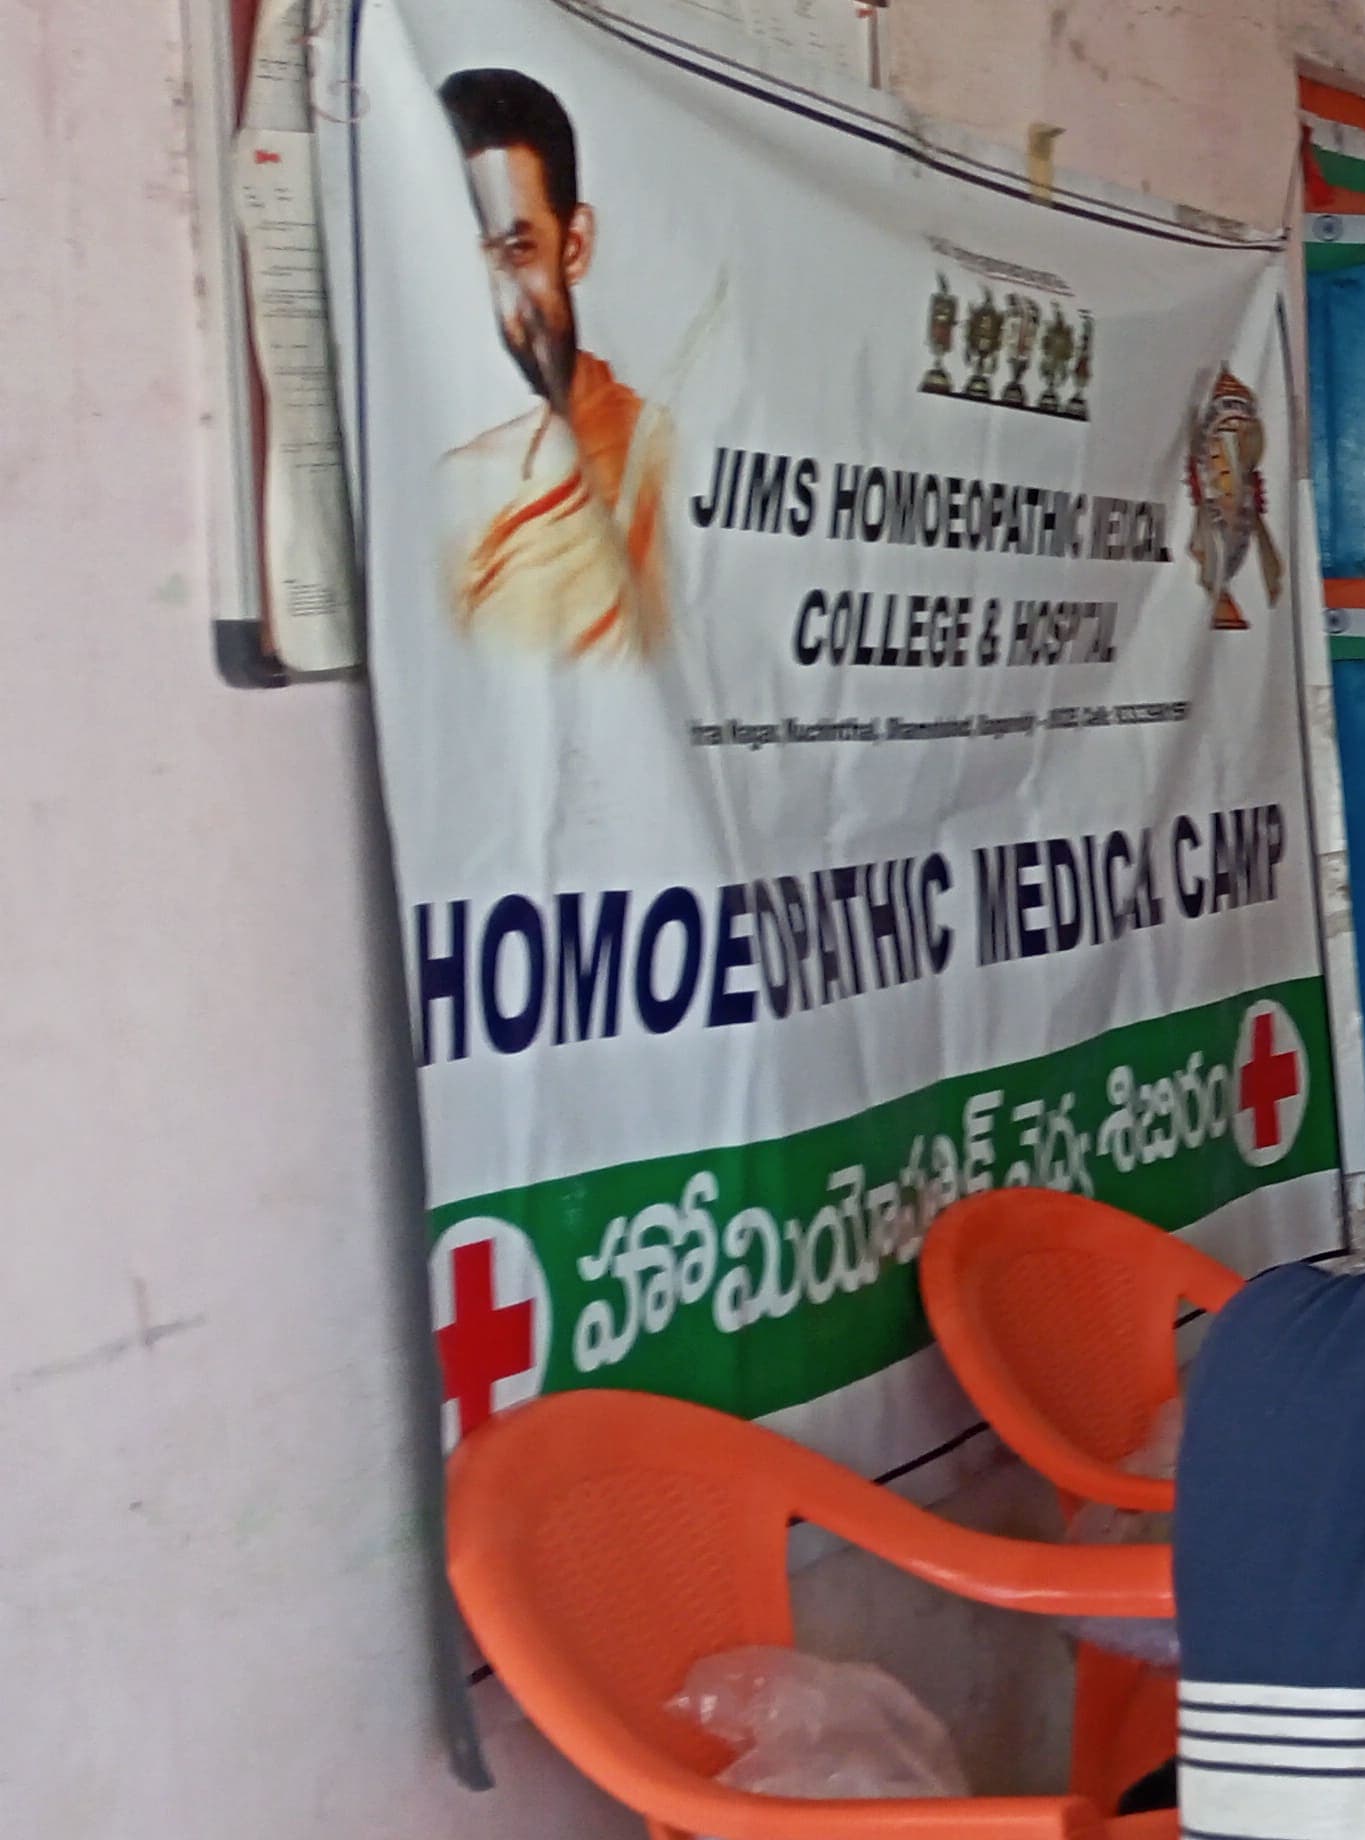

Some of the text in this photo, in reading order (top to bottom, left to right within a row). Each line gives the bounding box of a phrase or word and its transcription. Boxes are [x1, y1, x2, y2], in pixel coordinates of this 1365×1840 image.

[690, 447, 819, 537] JIMS
[827, 463, 1087, 559] HOMOEOPATHIC
[793, 588, 972, 668] COLLEGE
[976, 598, 1000, 668] &
[414, 803, 1284, 1067] HOMOEOPATHIC MEDICAL CAMP
[1097, 1051, 1230, 1173] శిబిరం
